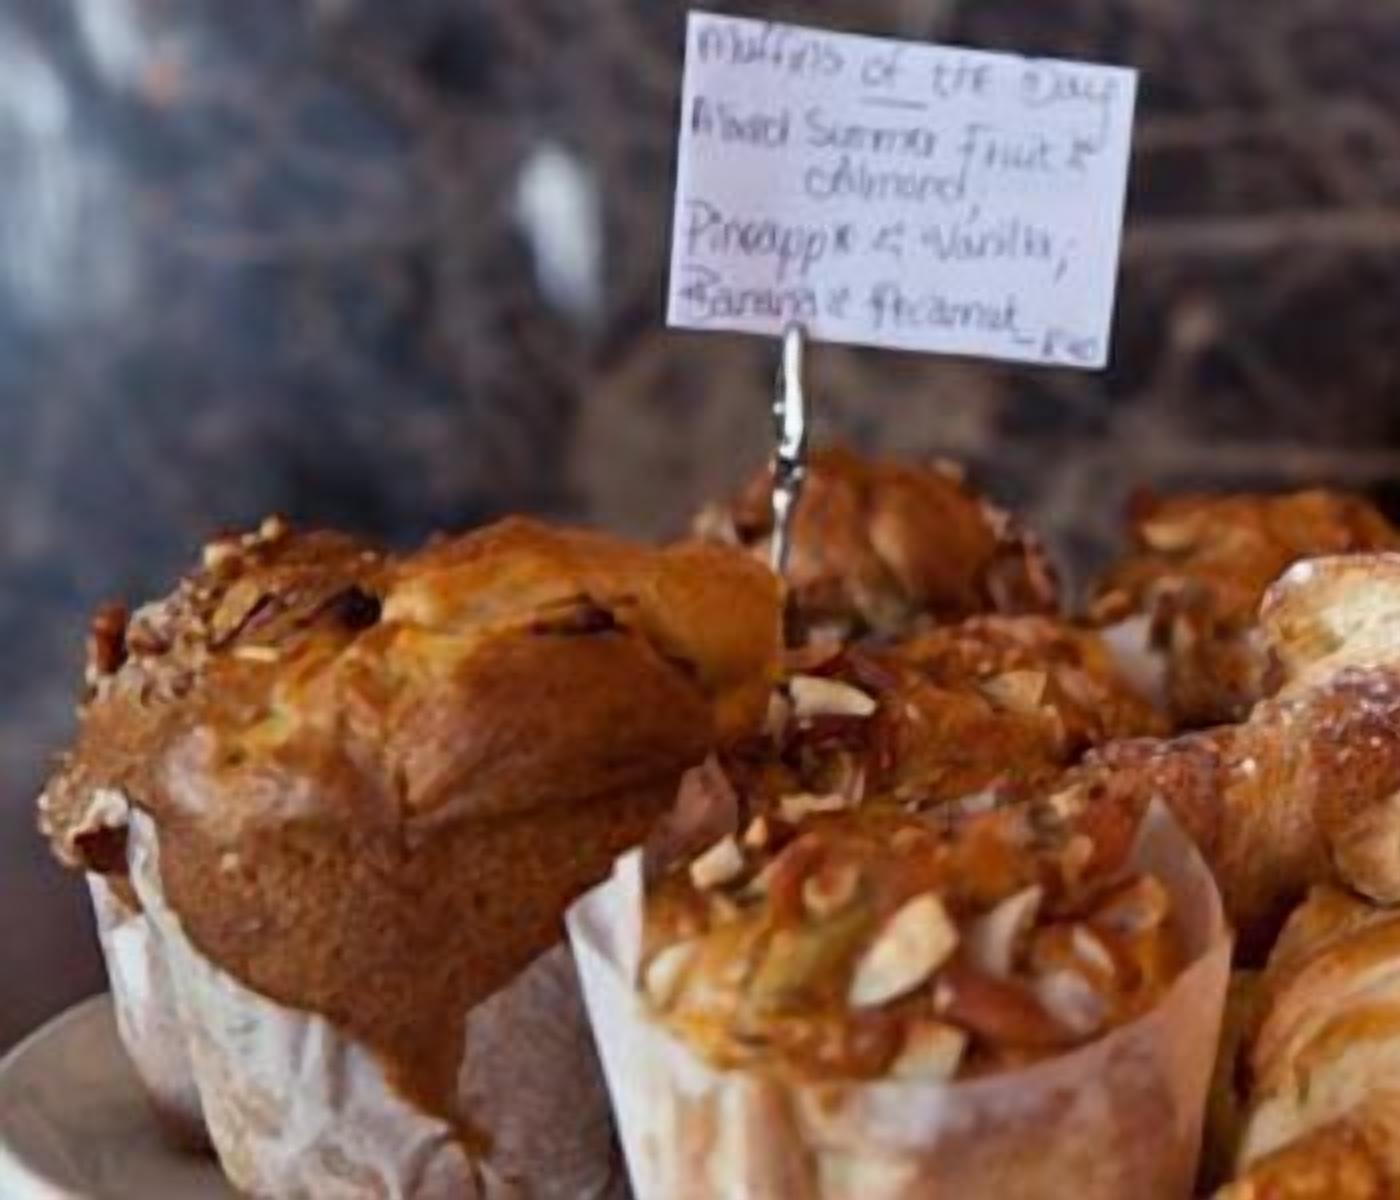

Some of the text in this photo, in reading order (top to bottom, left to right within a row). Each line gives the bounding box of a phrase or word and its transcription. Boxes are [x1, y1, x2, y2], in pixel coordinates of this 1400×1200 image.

[698, 22, 845, 76] Muffins
[860, 44, 904, 88] of
[804, 106, 938, 158] Summer
[679, 262, 818, 318] Banana
